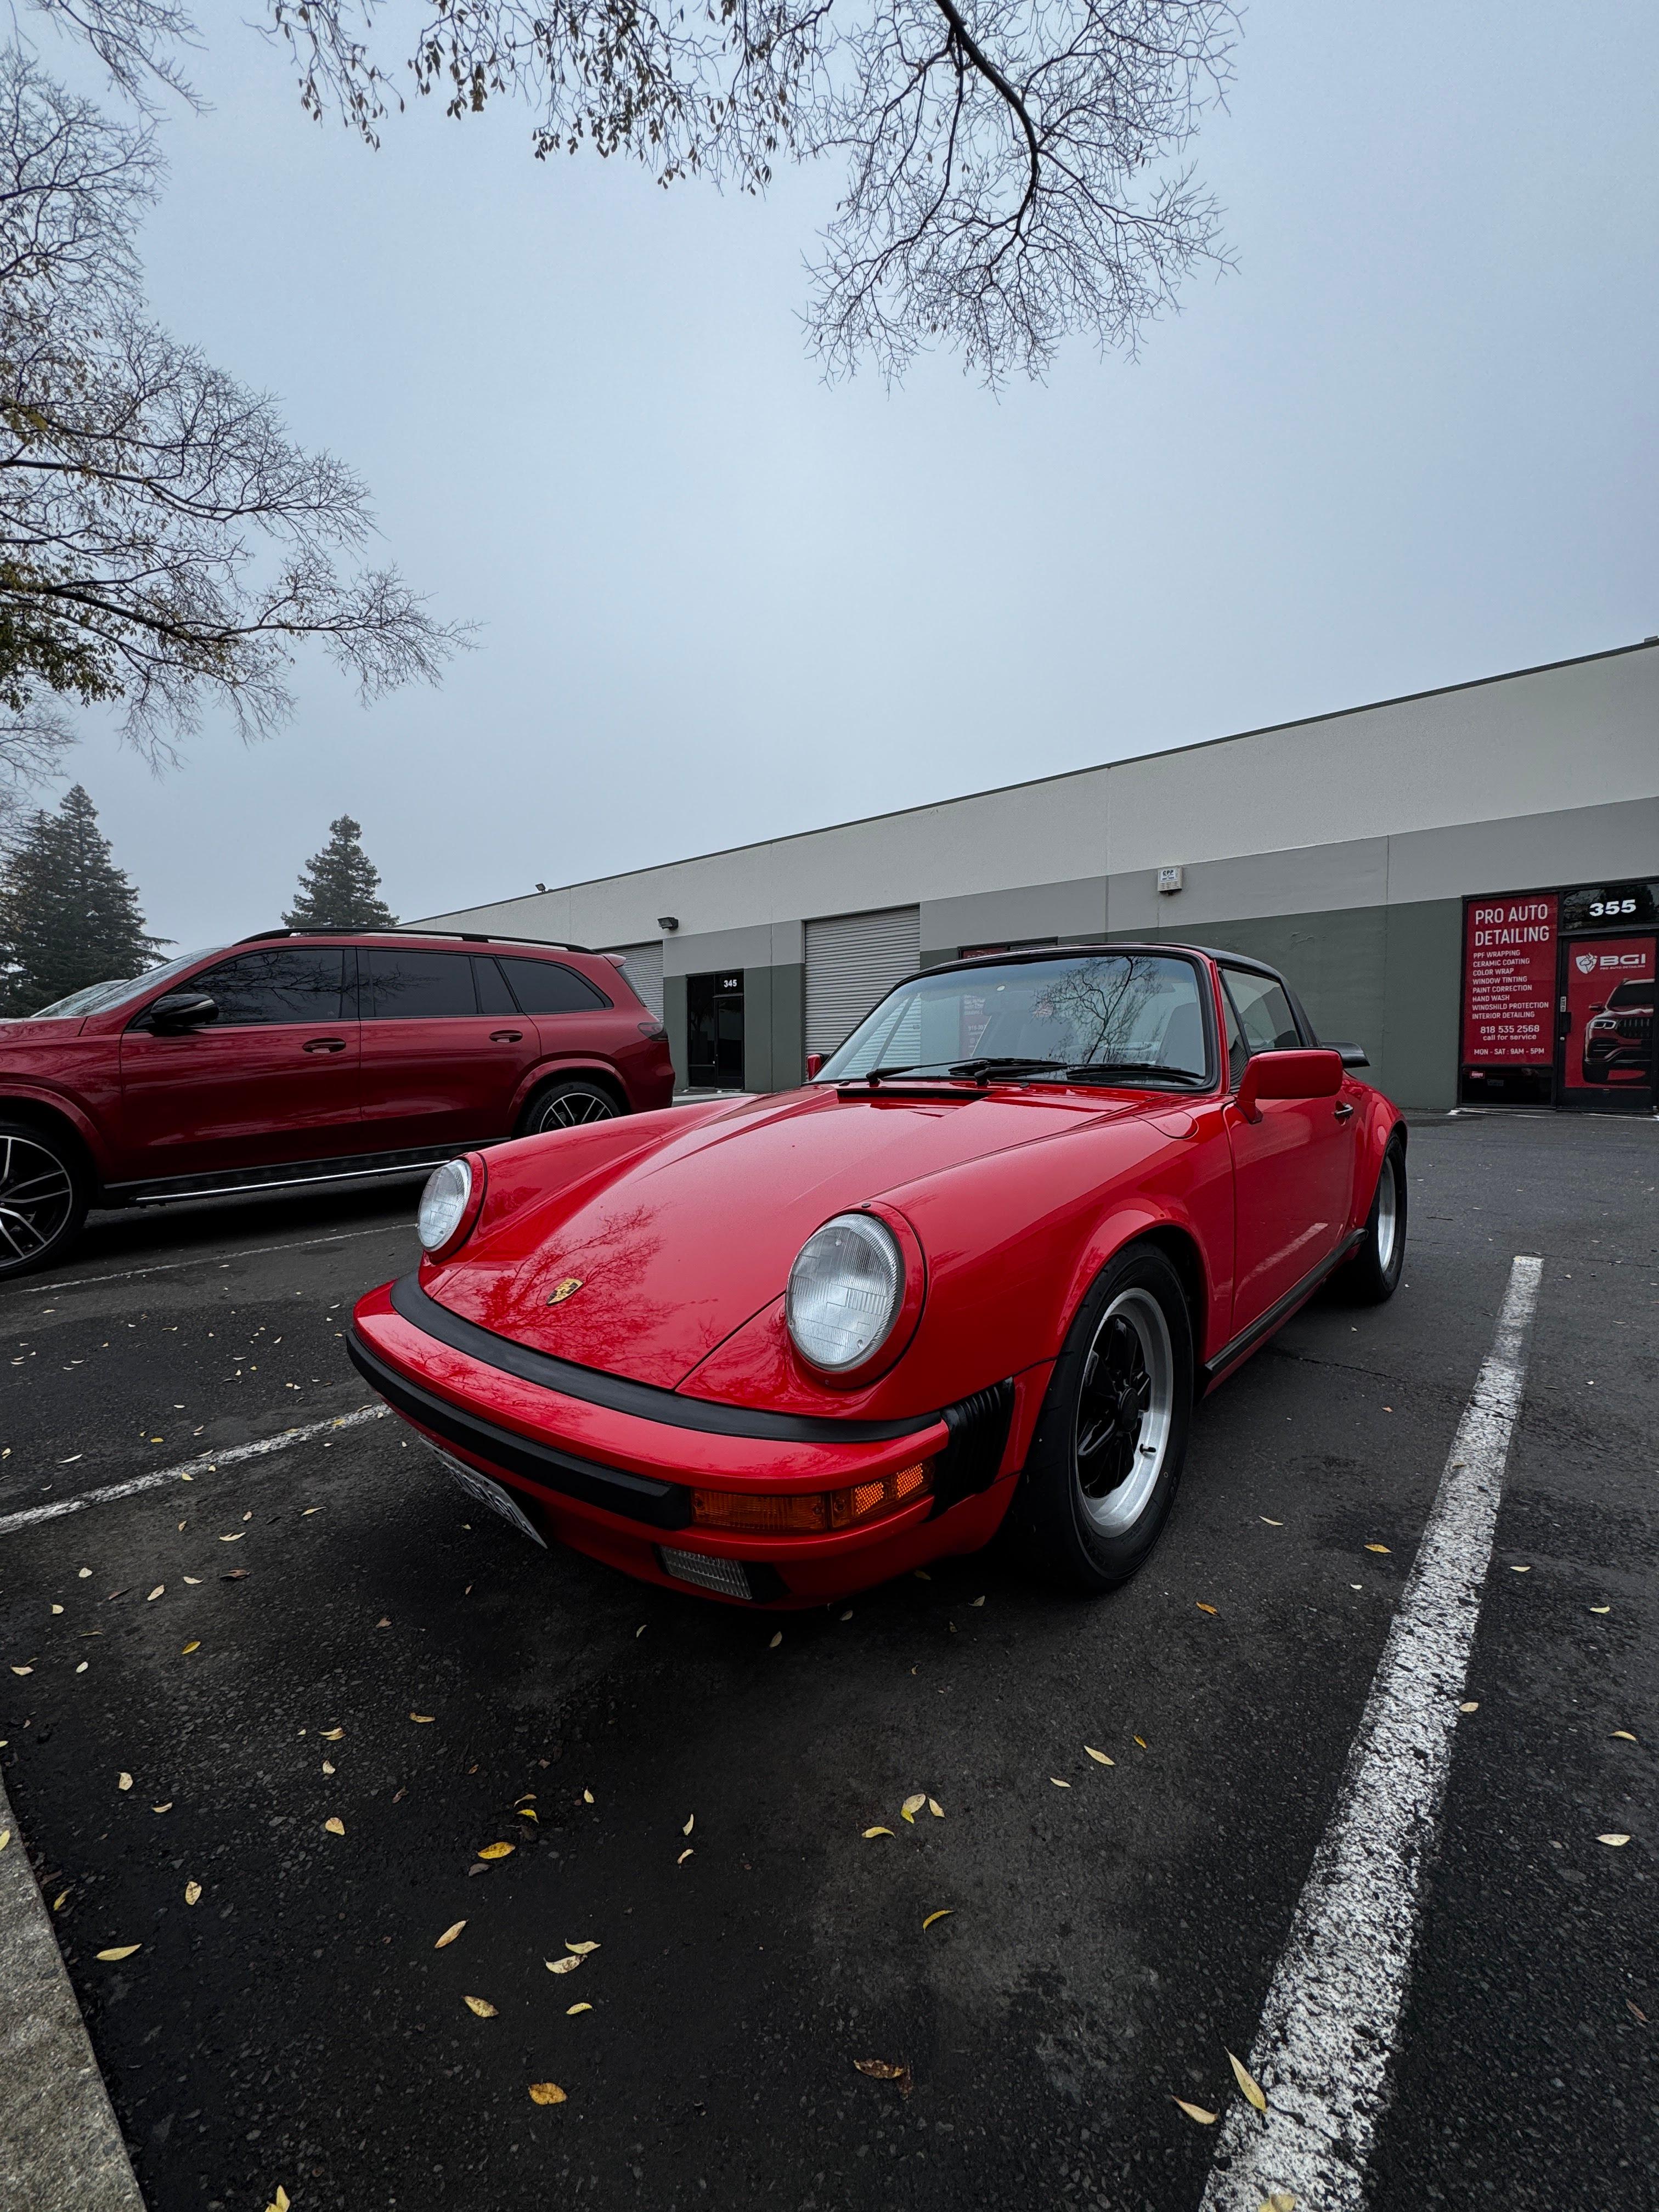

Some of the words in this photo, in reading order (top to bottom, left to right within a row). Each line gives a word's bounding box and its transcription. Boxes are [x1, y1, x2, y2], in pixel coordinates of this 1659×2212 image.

[1589, 899, 1637, 917] 355
[1475, 907, 1504, 925] PRO
[1508, 904, 1548, 922] AUTO
[1475, 926, 1549, 946] DETAILING
[1486, 950, 1521, 958] WRAPPING
[1600, 953, 1646, 966] BGI
[1473, 960, 1502, 968] CERAMIC
[1503, 958, 1530, 966] COATING
[724, 979, 737, 988] 345
[1480, 1025, 1496, 1034] 818
[1516, 1025, 1540, 1033] 2568
